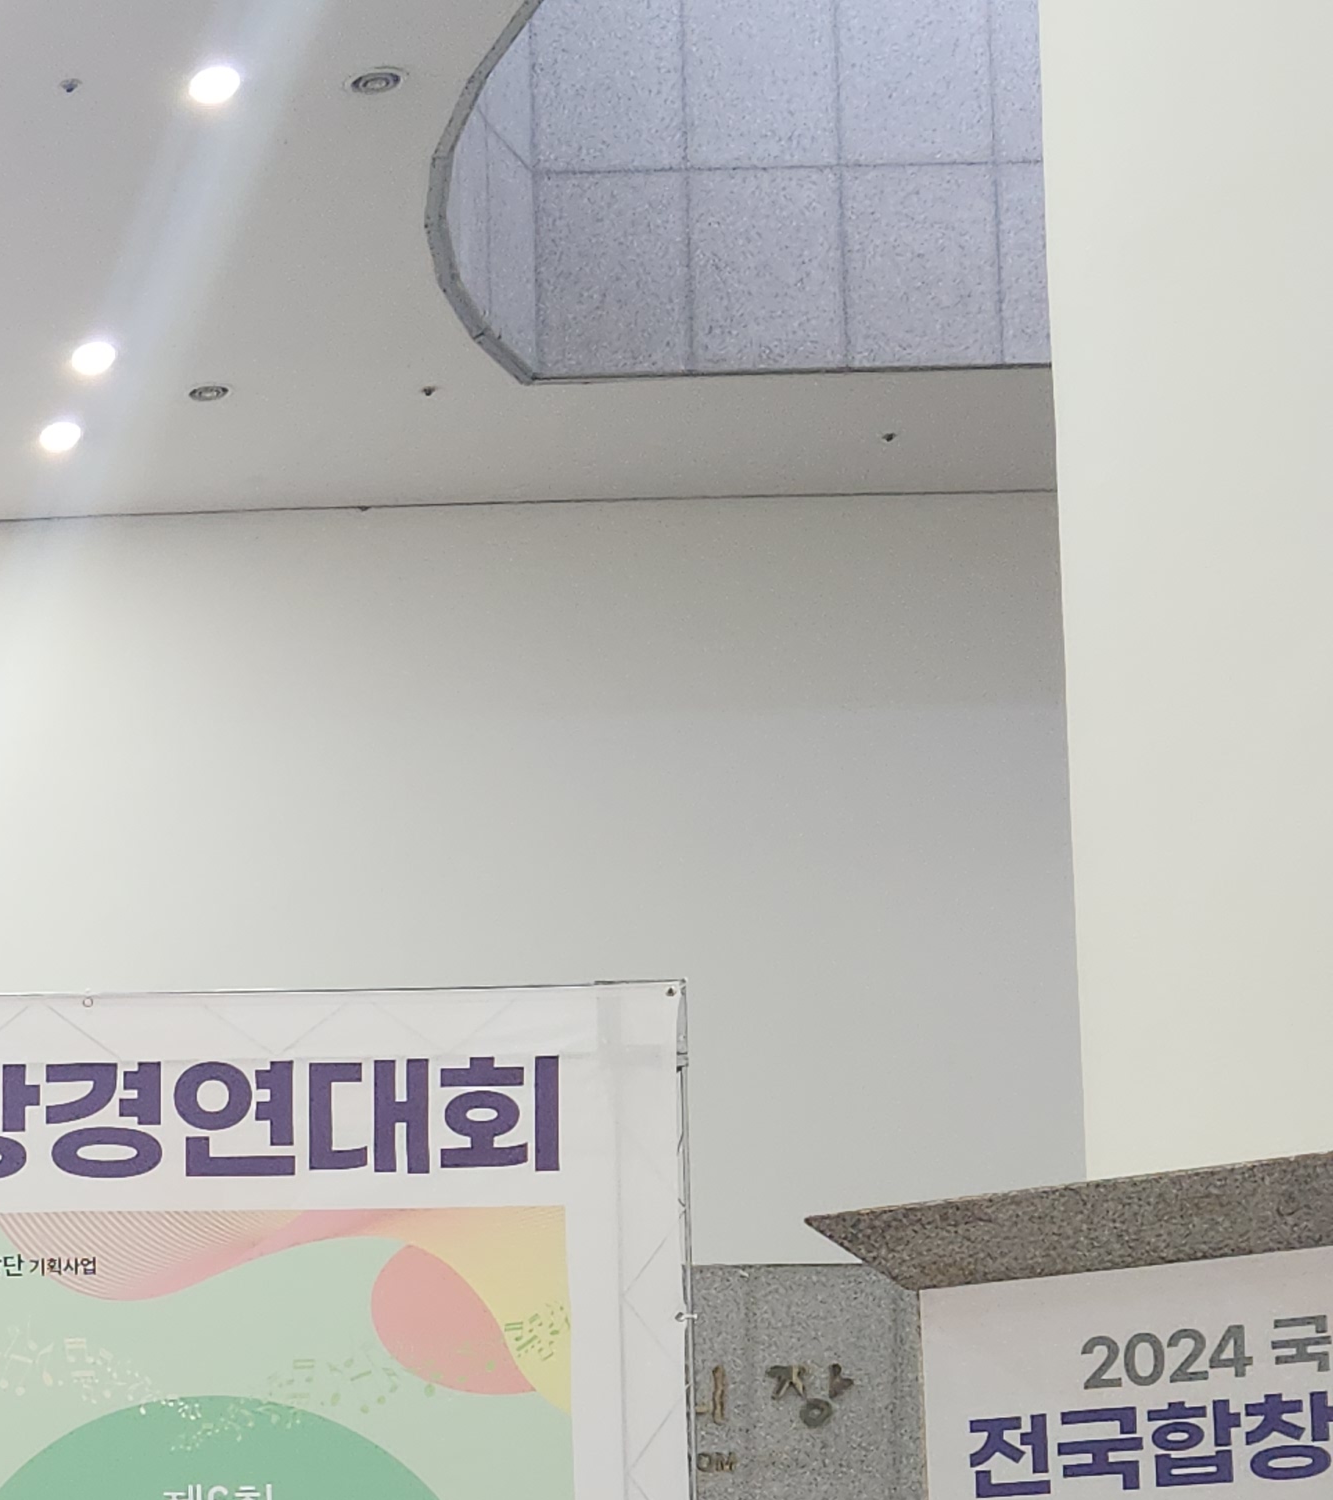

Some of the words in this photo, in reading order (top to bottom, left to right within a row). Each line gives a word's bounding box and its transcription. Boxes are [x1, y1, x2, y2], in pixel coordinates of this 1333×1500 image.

[29, 1256, 98, 1278] 기획사업
[1081, 1324, 1253, 1391] 2024
[968, 1390, 1333, 1499] 전국합창
